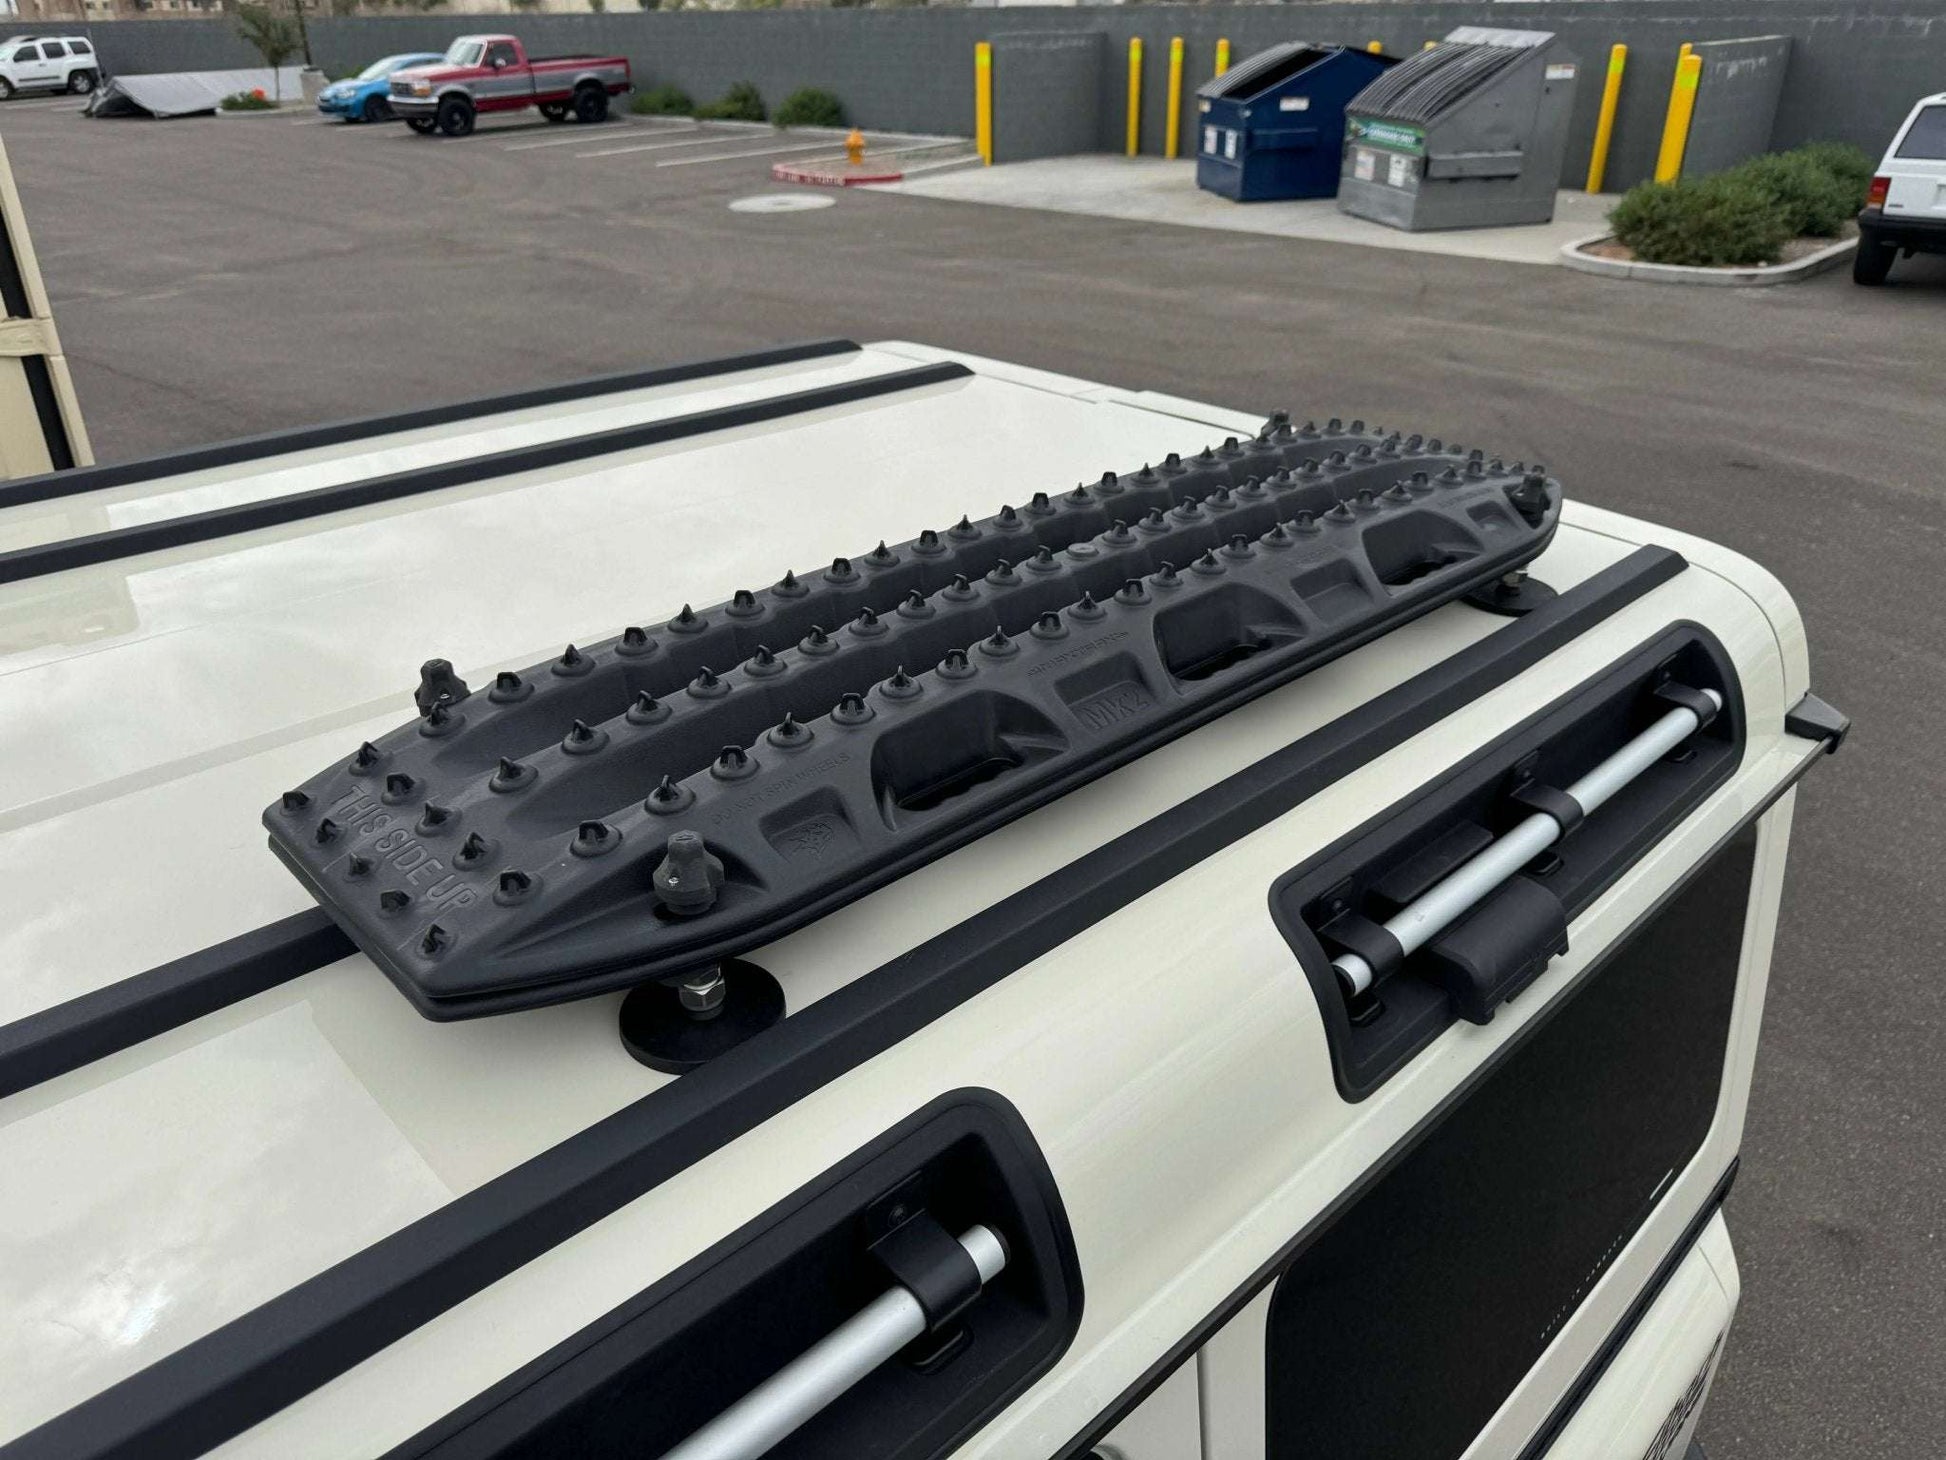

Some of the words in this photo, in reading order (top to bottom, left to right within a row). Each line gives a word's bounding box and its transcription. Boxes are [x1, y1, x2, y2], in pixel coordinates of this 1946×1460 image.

[330, 784, 393, 836] THIS
[373, 828, 444, 887] SIDE
[424, 872, 478, 911] UP
